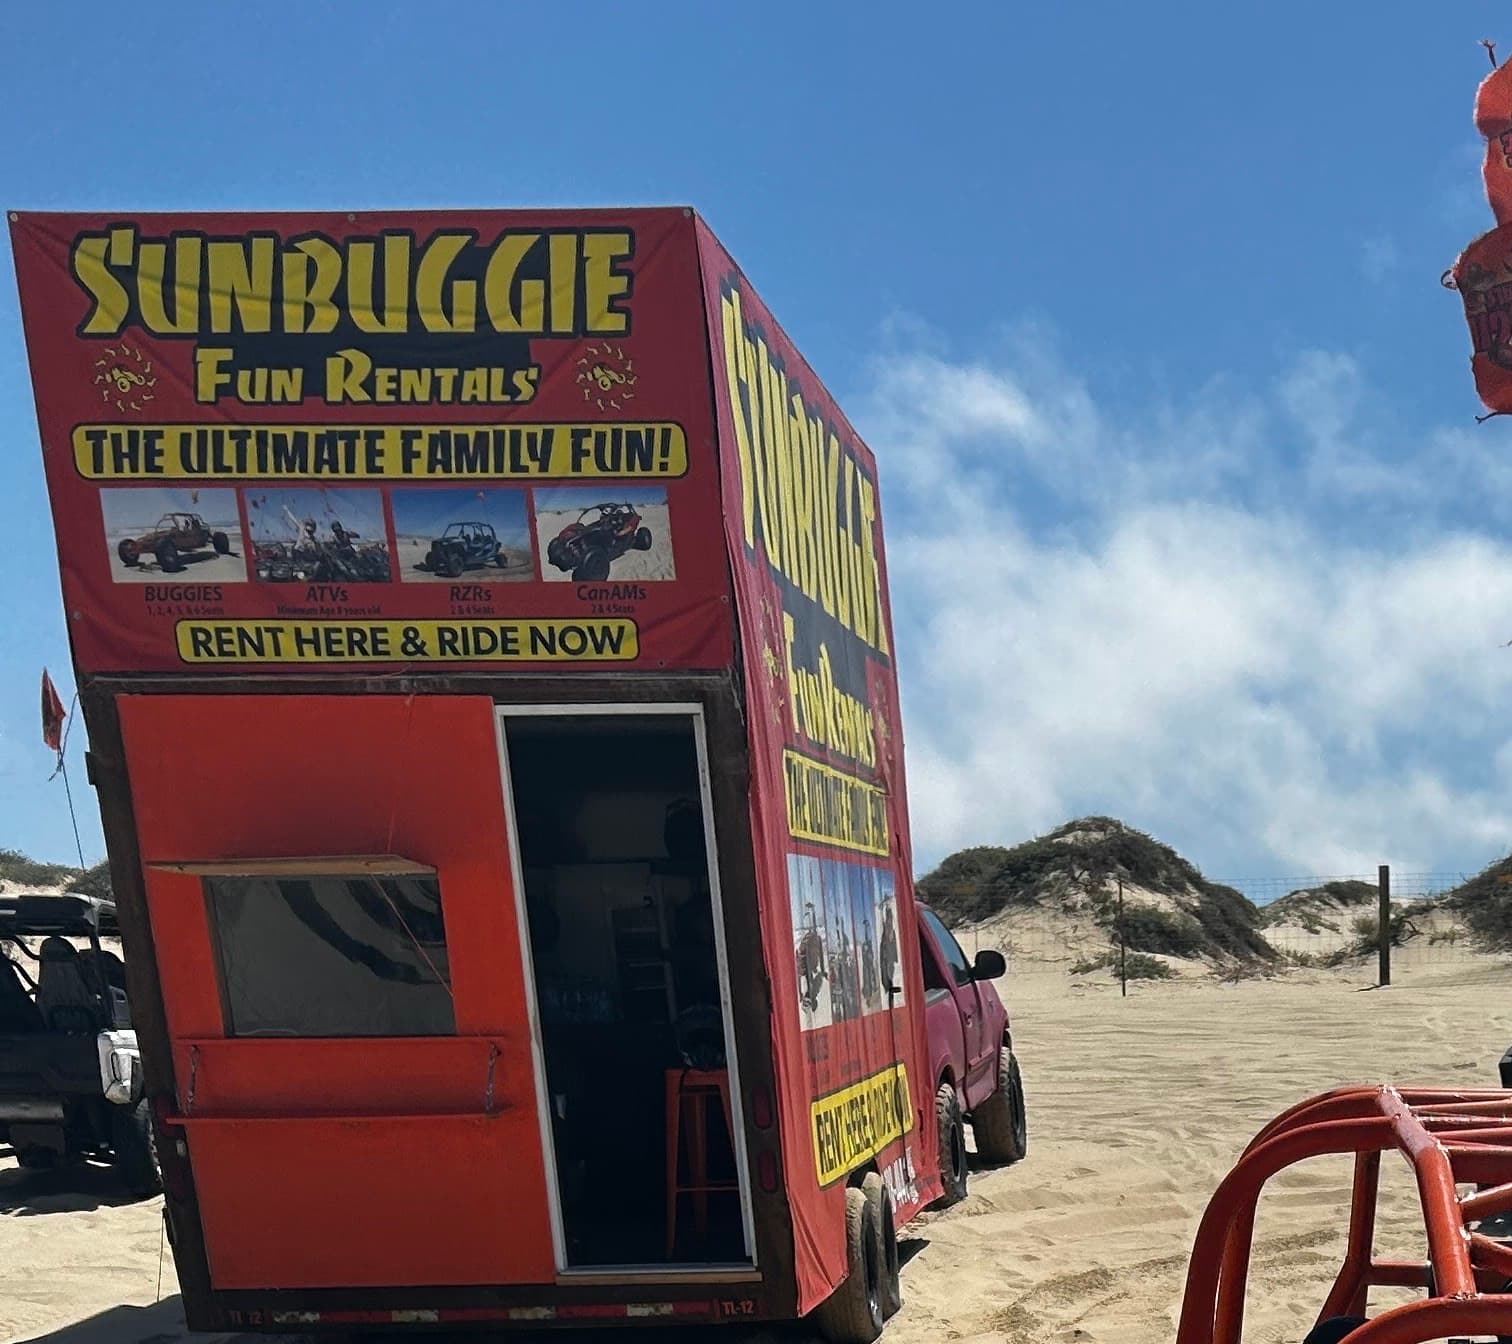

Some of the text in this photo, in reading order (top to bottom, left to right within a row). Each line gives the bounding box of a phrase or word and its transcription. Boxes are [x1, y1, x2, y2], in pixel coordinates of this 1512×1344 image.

[73, 228, 631, 335] SUNBUGGIE
[195, 346, 540, 405] FUN RENTALS
[84, 426, 673, 475] THE ULTIMATE FAMILY FUN!
[144, 585, 223, 601] BUGGIES
[306, 585, 349, 601] ATVs
[450, 585, 492, 601] RZRs
[577, 584, 648, 601] CanAMs
[190, 625, 626, 658] RENT HERE & RIDE NOW
[816, 1102, 846, 1175] RENT
